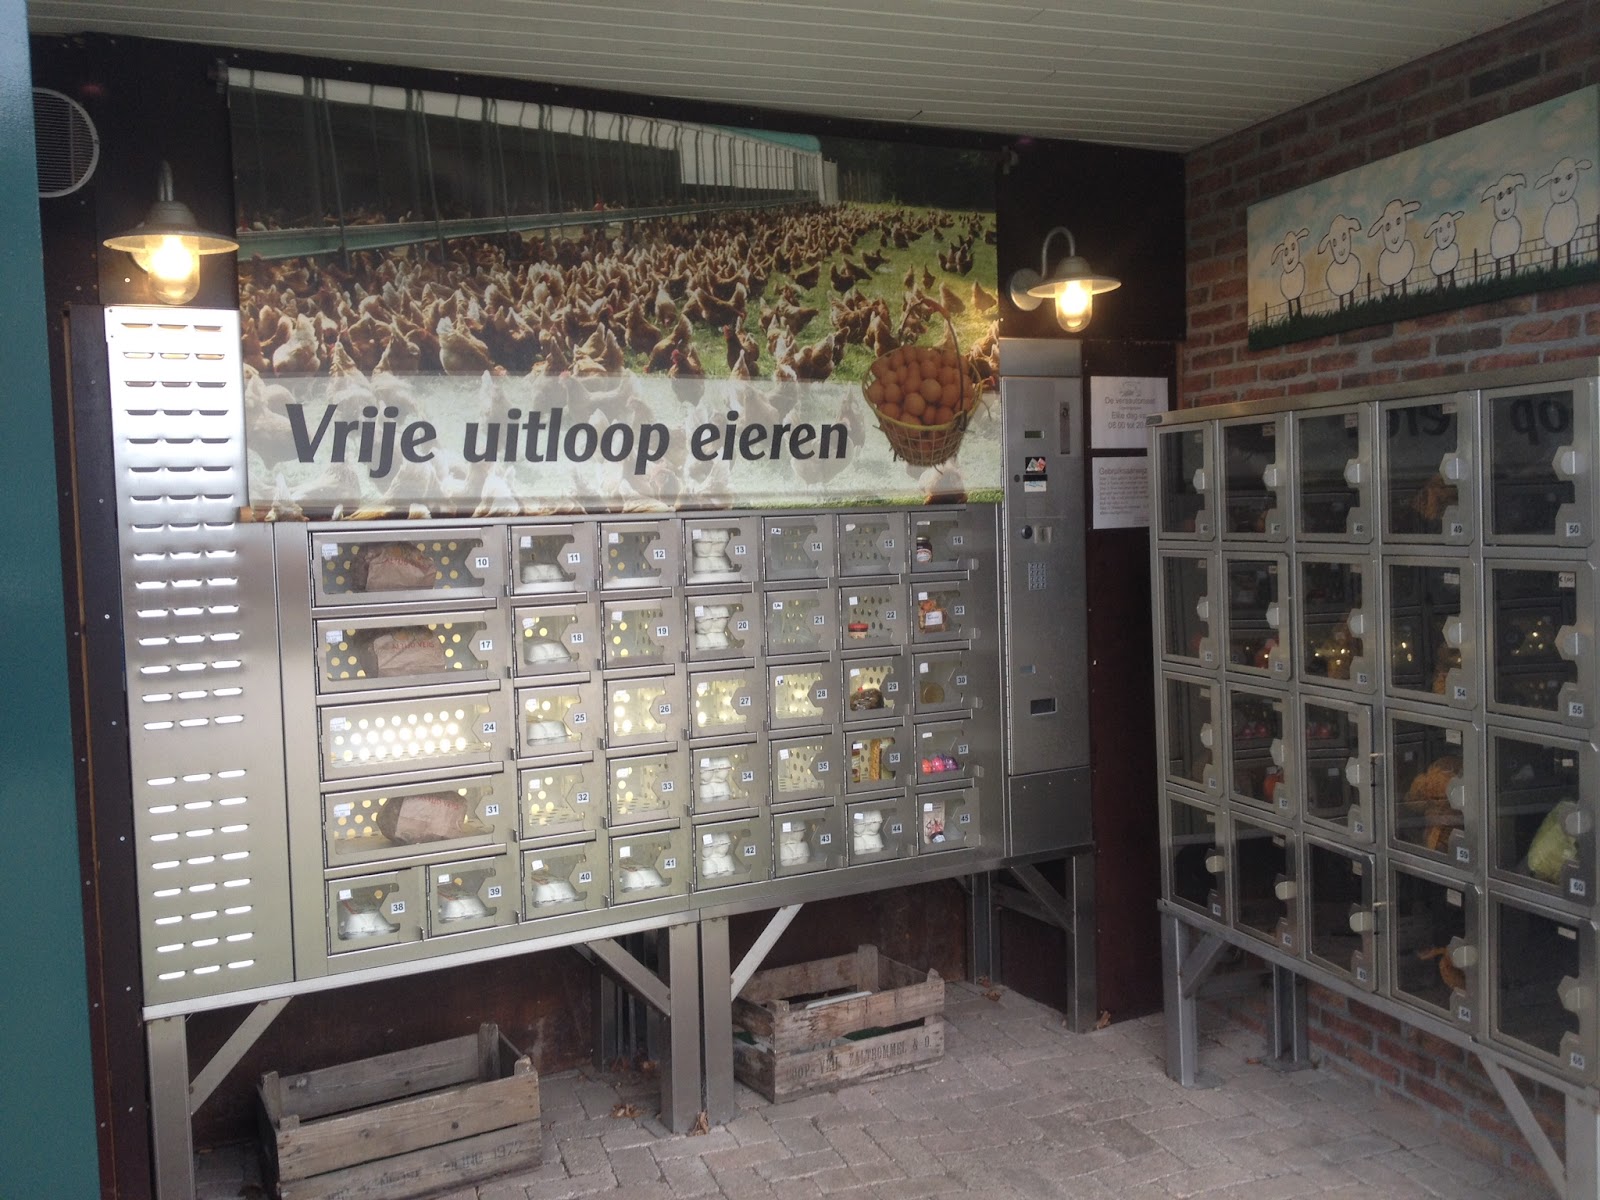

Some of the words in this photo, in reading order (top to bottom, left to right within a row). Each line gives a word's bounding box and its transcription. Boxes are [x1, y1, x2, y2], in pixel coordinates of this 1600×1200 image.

[285, 403, 437, 478] Vrije
[463, 407, 670, 475] uitloop
[690, 410, 848, 460] eieren
